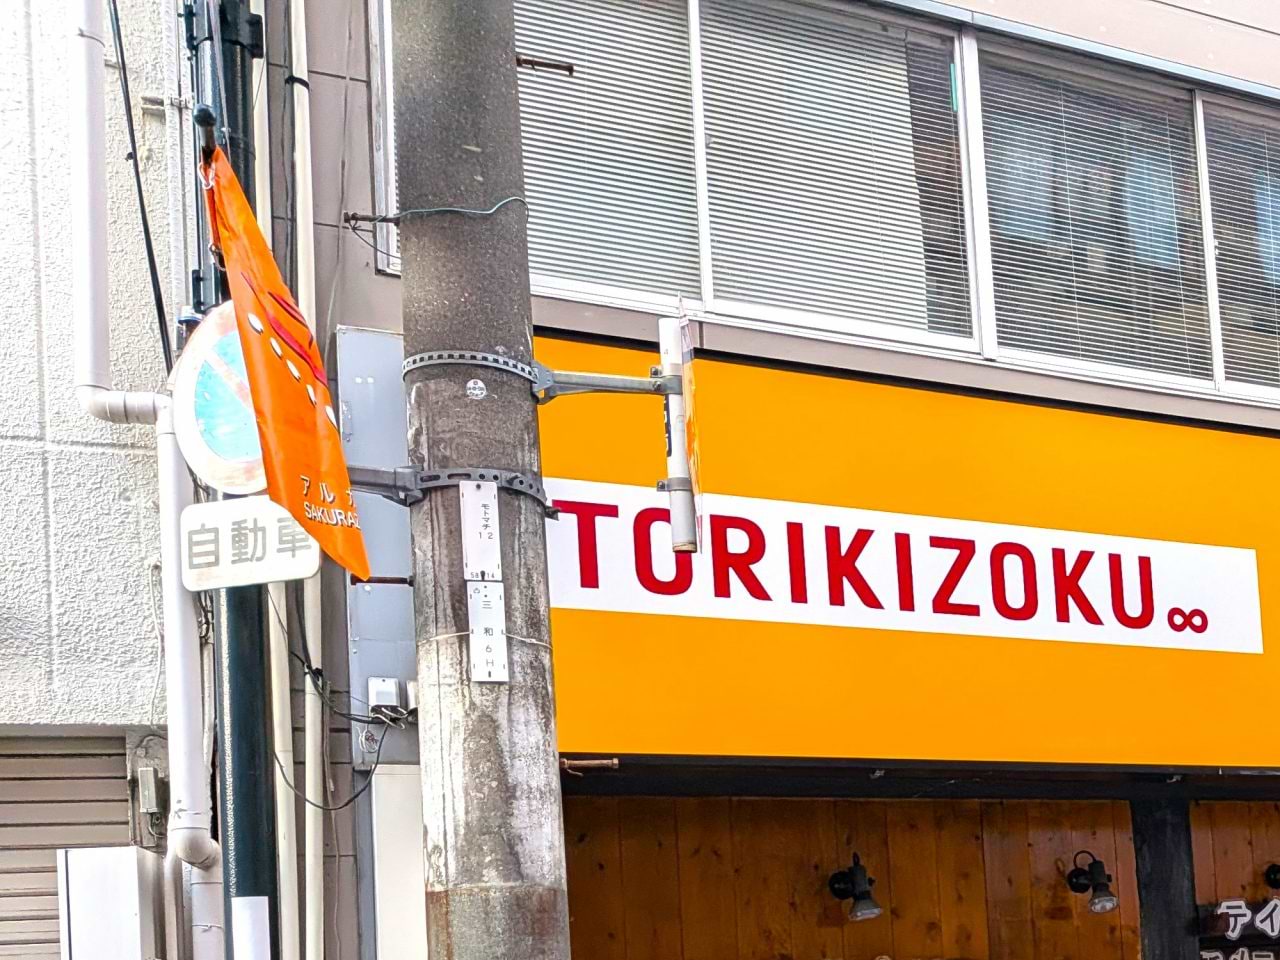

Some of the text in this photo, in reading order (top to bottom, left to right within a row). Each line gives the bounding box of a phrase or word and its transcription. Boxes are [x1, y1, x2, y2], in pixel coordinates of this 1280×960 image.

[481, 503, 491, 530] モトマチ
[187, 517, 312, 570] 自動車
[552, 499, 1155, 629] TORIKIZOKU
